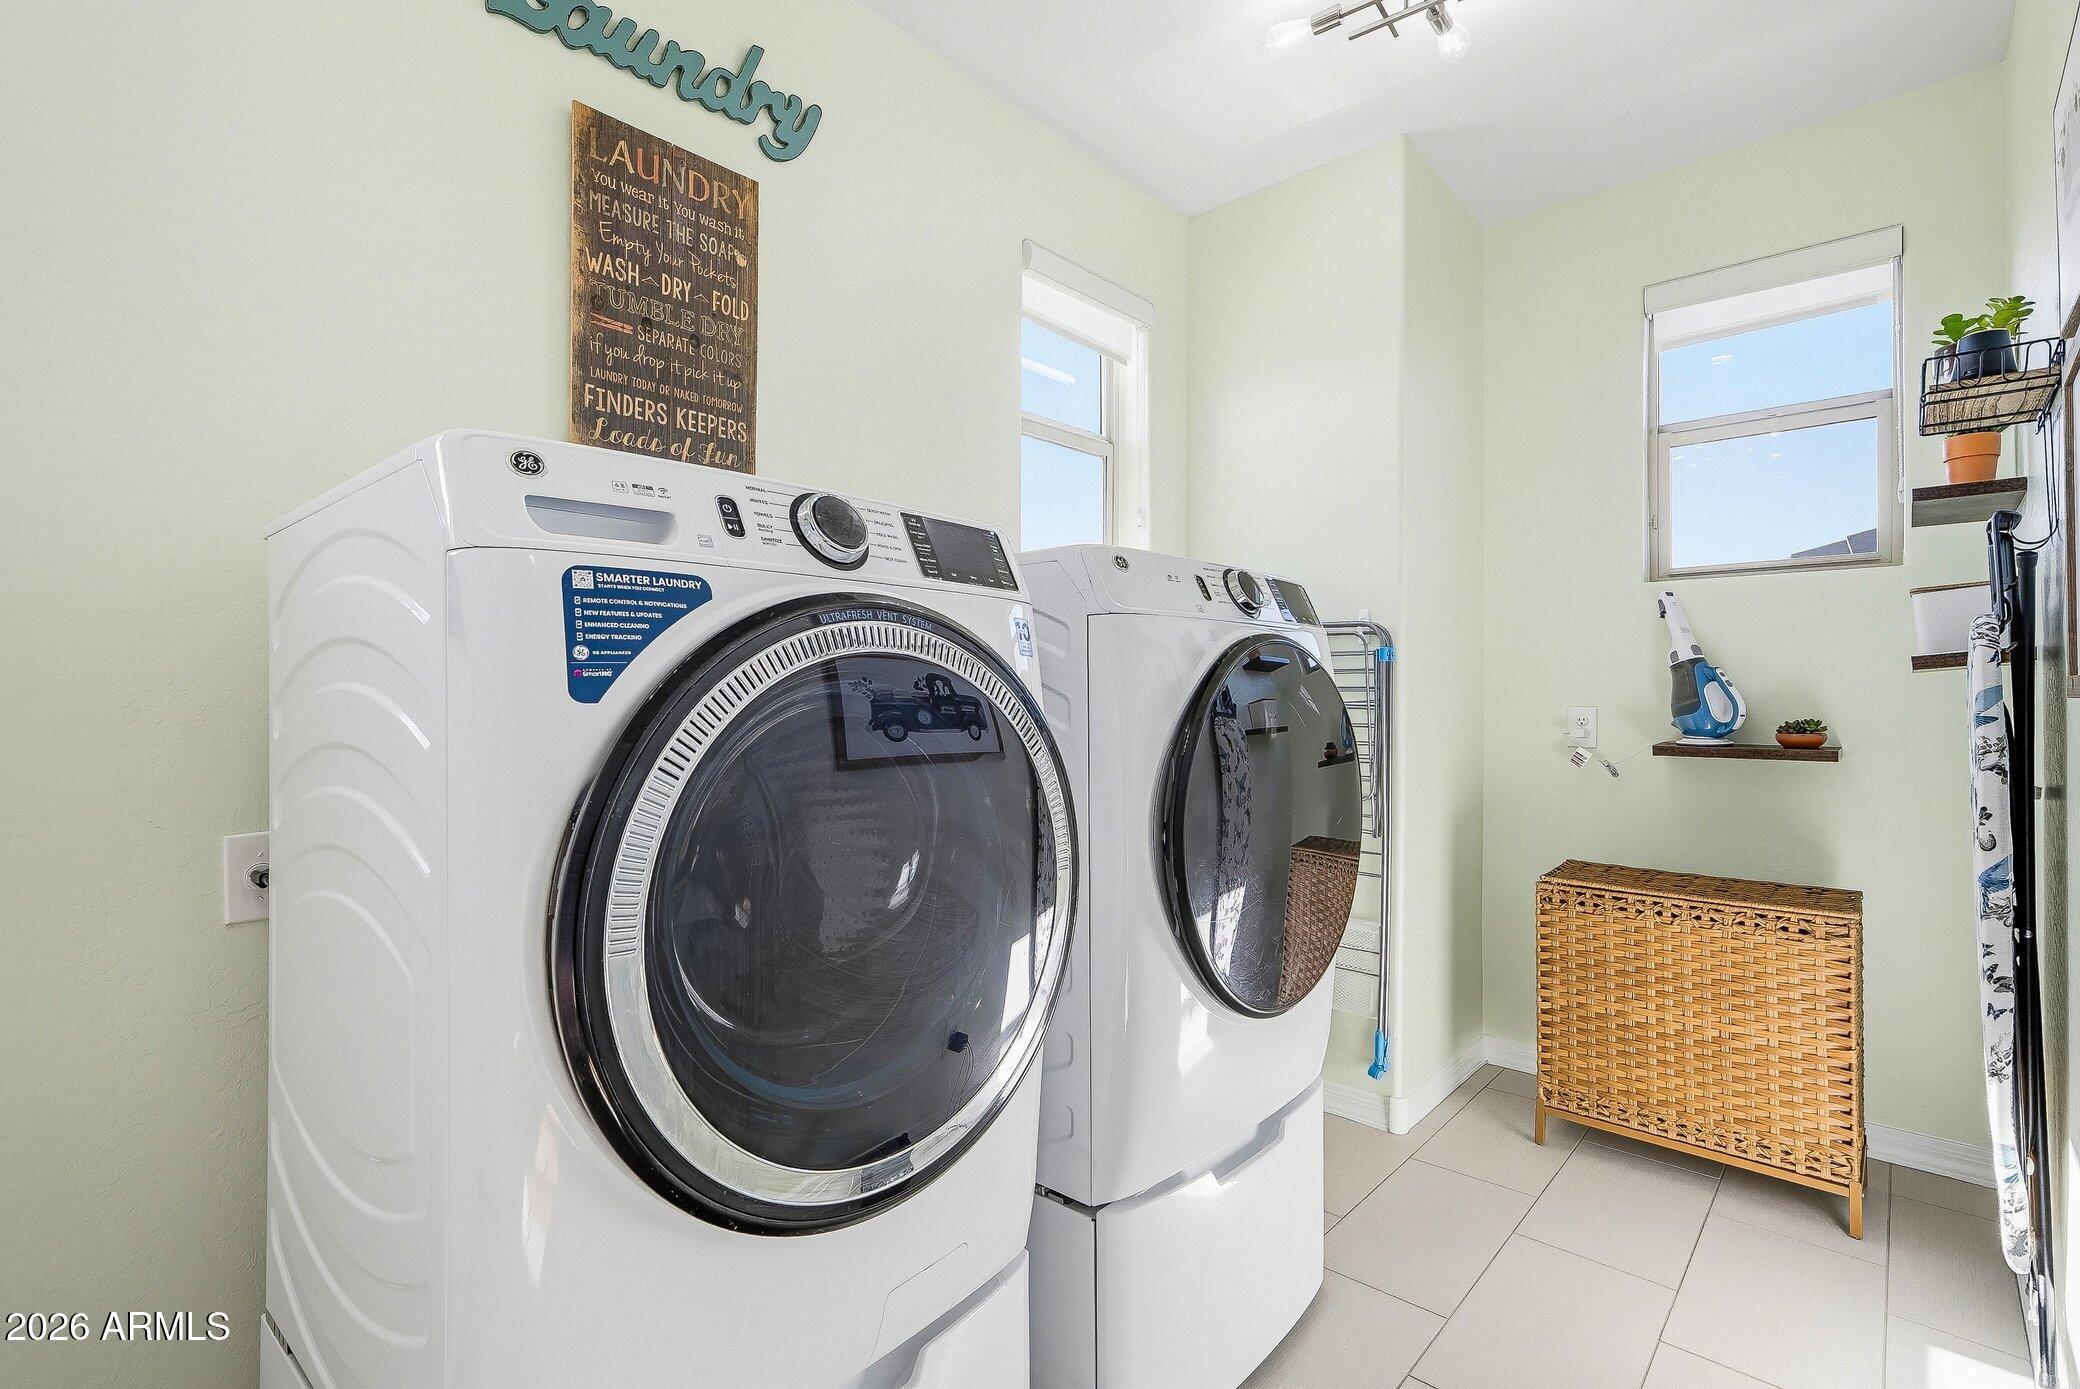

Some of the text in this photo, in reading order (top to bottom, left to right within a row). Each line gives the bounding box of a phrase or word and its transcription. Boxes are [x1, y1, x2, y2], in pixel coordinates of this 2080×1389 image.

[589, 126, 749, 220] LAUNDRY
[589, 189, 739, 262] MEASURE THE SOAP
[620, 181, 654, 205] wear
[658, 195, 670, 211] it
[698, 213, 732, 235] wash
[734, 225, 745, 241] it
[585, 246, 749, 321] WASH DRY FOLD
[599, 221, 651, 266] Empty
[688, 250, 738, 289] Pockets
[589, 278, 745, 347] TUMBLE DRY
[590, 333, 742, 399] if you drop it pick it up
[637, 325, 742, 369] SEPARATE COLORS
[583, 383, 747, 443] FINDERS KEEPERS
[590, 366, 744, 414] LAUNDRY TODAY OR NAKED TOMORROW
[588, 418, 743, 468] Loads of Fun
[596, 573, 701, 590] SMARTER LAUNDRY
[608, 598, 639, 606] CONTROL
[819, 610, 933, 631] ULTRAFRESH VENT SYSTEM
